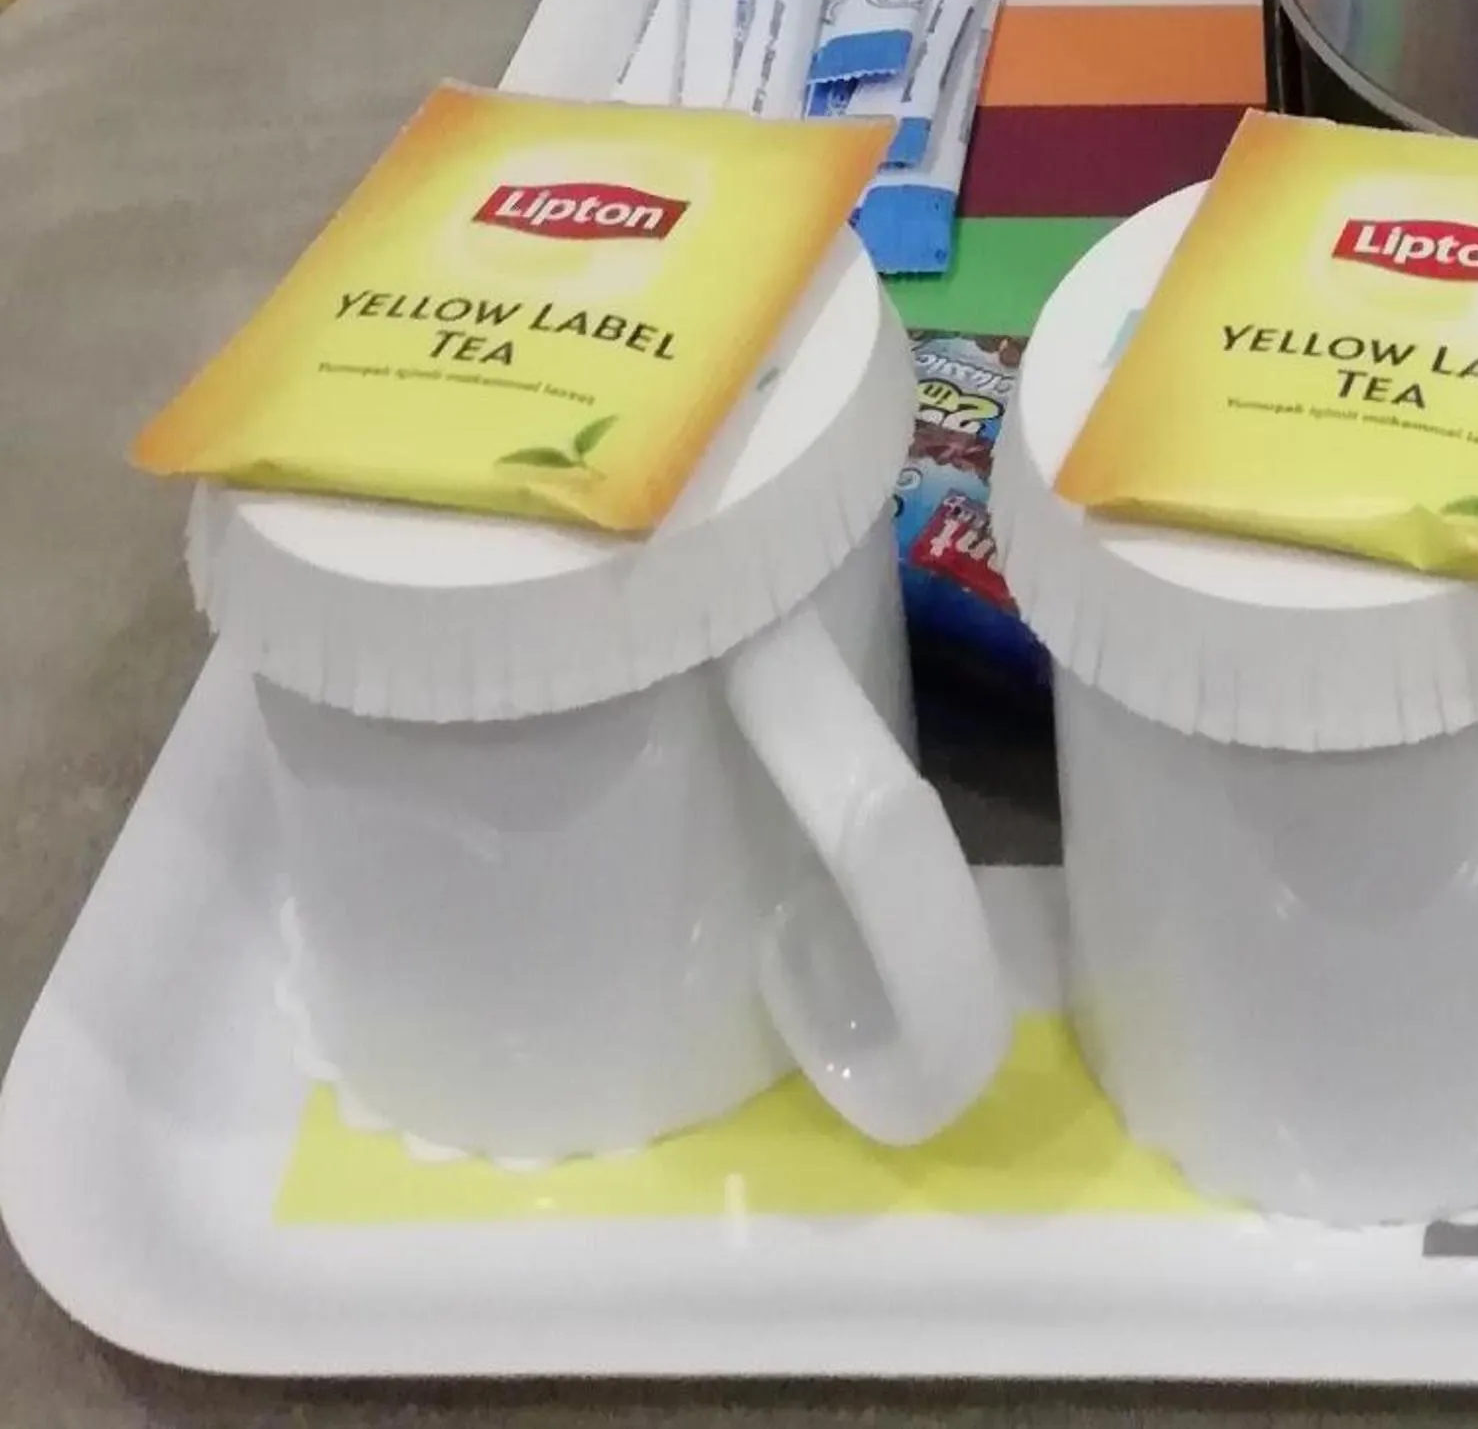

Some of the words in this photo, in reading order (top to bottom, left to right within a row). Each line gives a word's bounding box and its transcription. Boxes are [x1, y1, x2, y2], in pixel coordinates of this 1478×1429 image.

[495, 189, 664, 231] Lipton
[335, 289, 523, 328] YELLOW
[528, 302, 677, 361] LABEL
[1222, 323, 1417, 367] YELLOW
[429, 329, 516, 367] TEA
[1336, 368, 1427, 410] TEA
